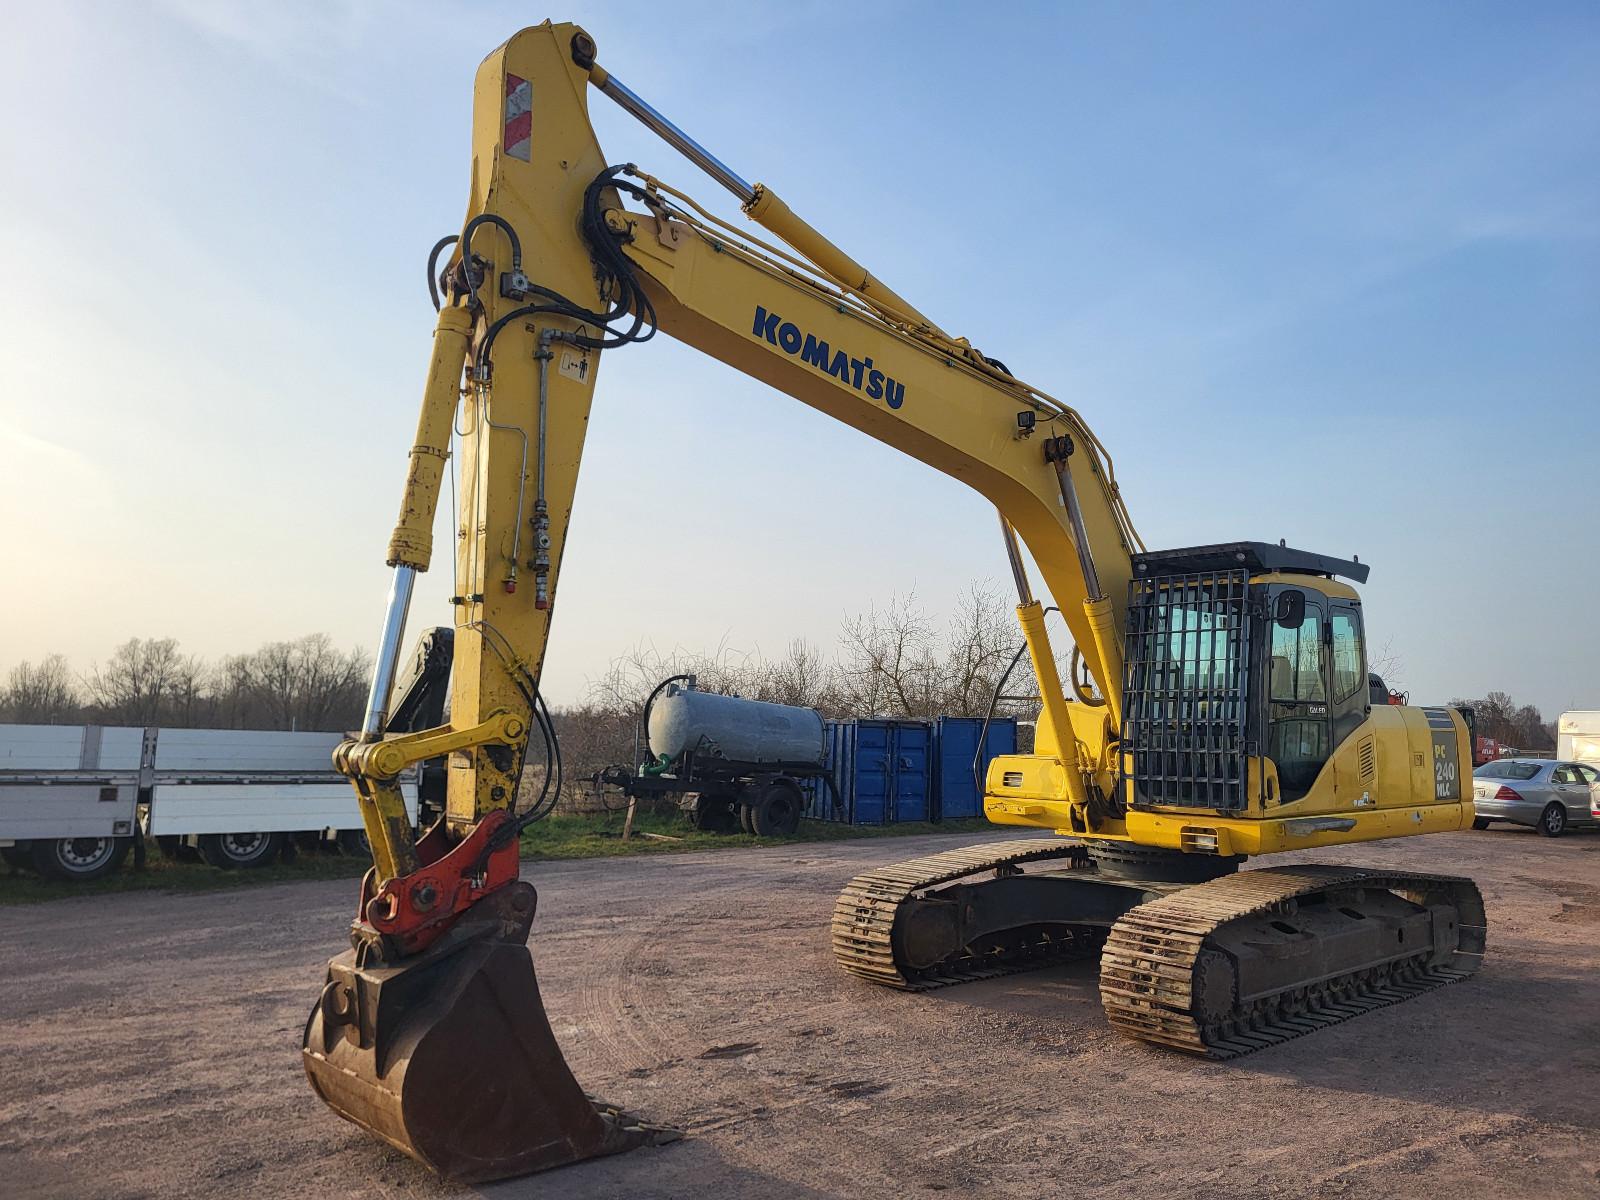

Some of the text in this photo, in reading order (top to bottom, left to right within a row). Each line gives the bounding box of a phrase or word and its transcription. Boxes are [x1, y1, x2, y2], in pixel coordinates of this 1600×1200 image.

[752, 305, 905, 409] KOMATSU
[1434, 744, 1446, 759] PC
[1435, 762, 1455, 781] 240
[1436, 782, 1450, 797] NLC
